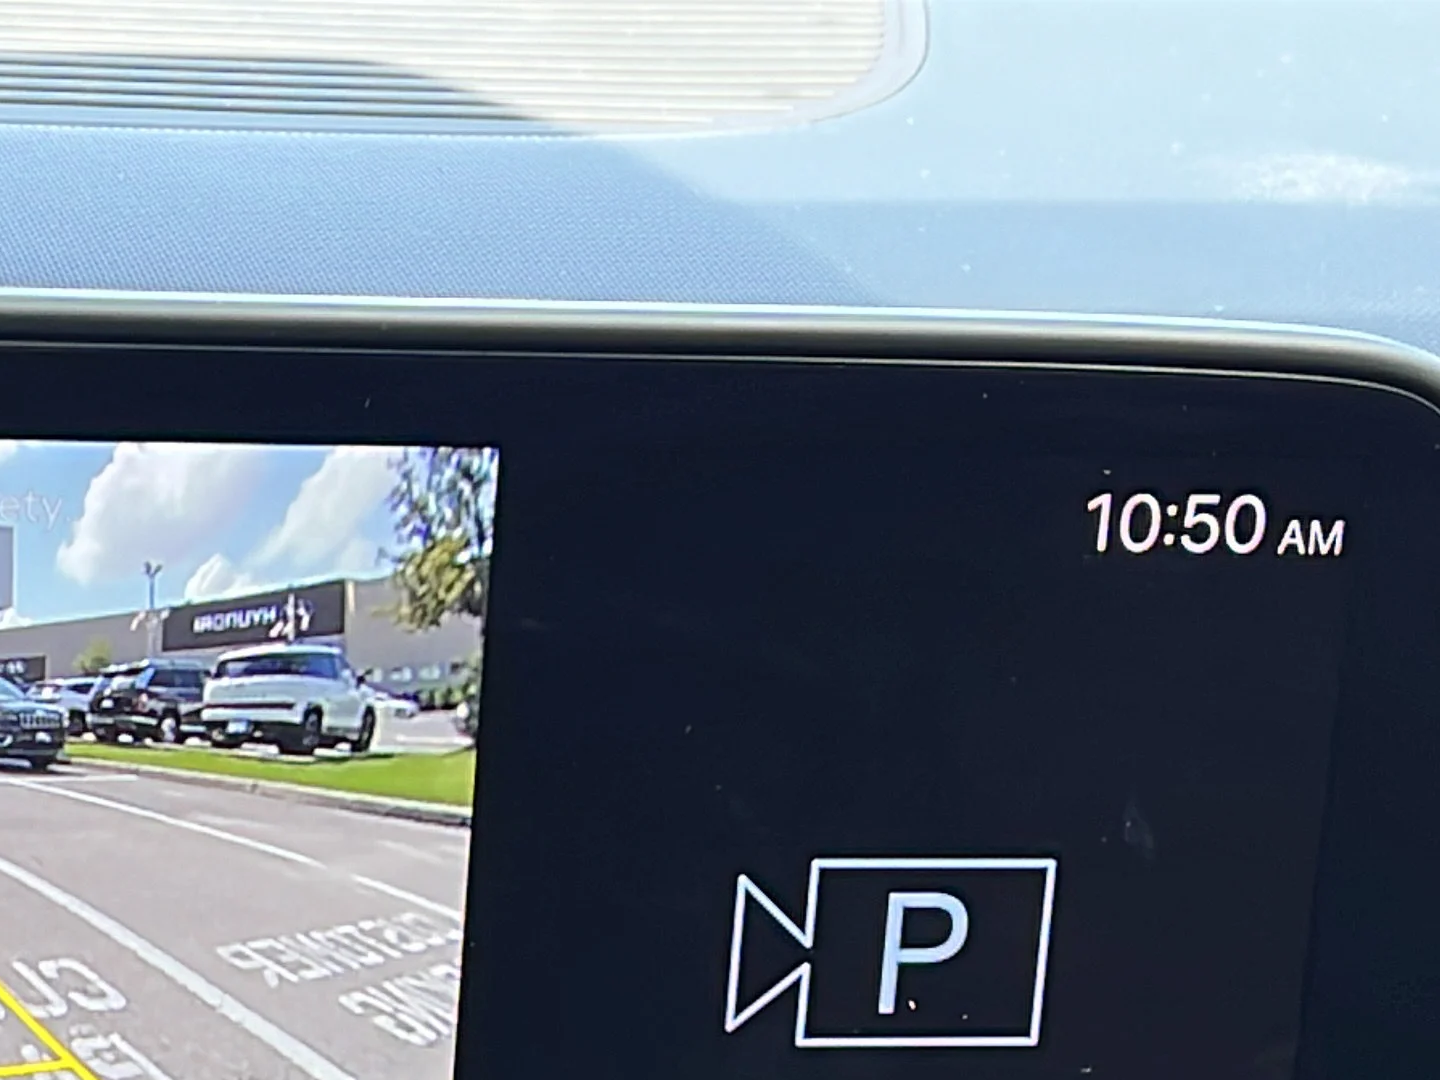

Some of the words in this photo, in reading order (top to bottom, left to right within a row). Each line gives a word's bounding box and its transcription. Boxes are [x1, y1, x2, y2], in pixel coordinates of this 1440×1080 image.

[1086, 492, 1267, 554] 10:50
[1276, 519, 1346, 556] AM
[878, 892, 969, 1014] P
